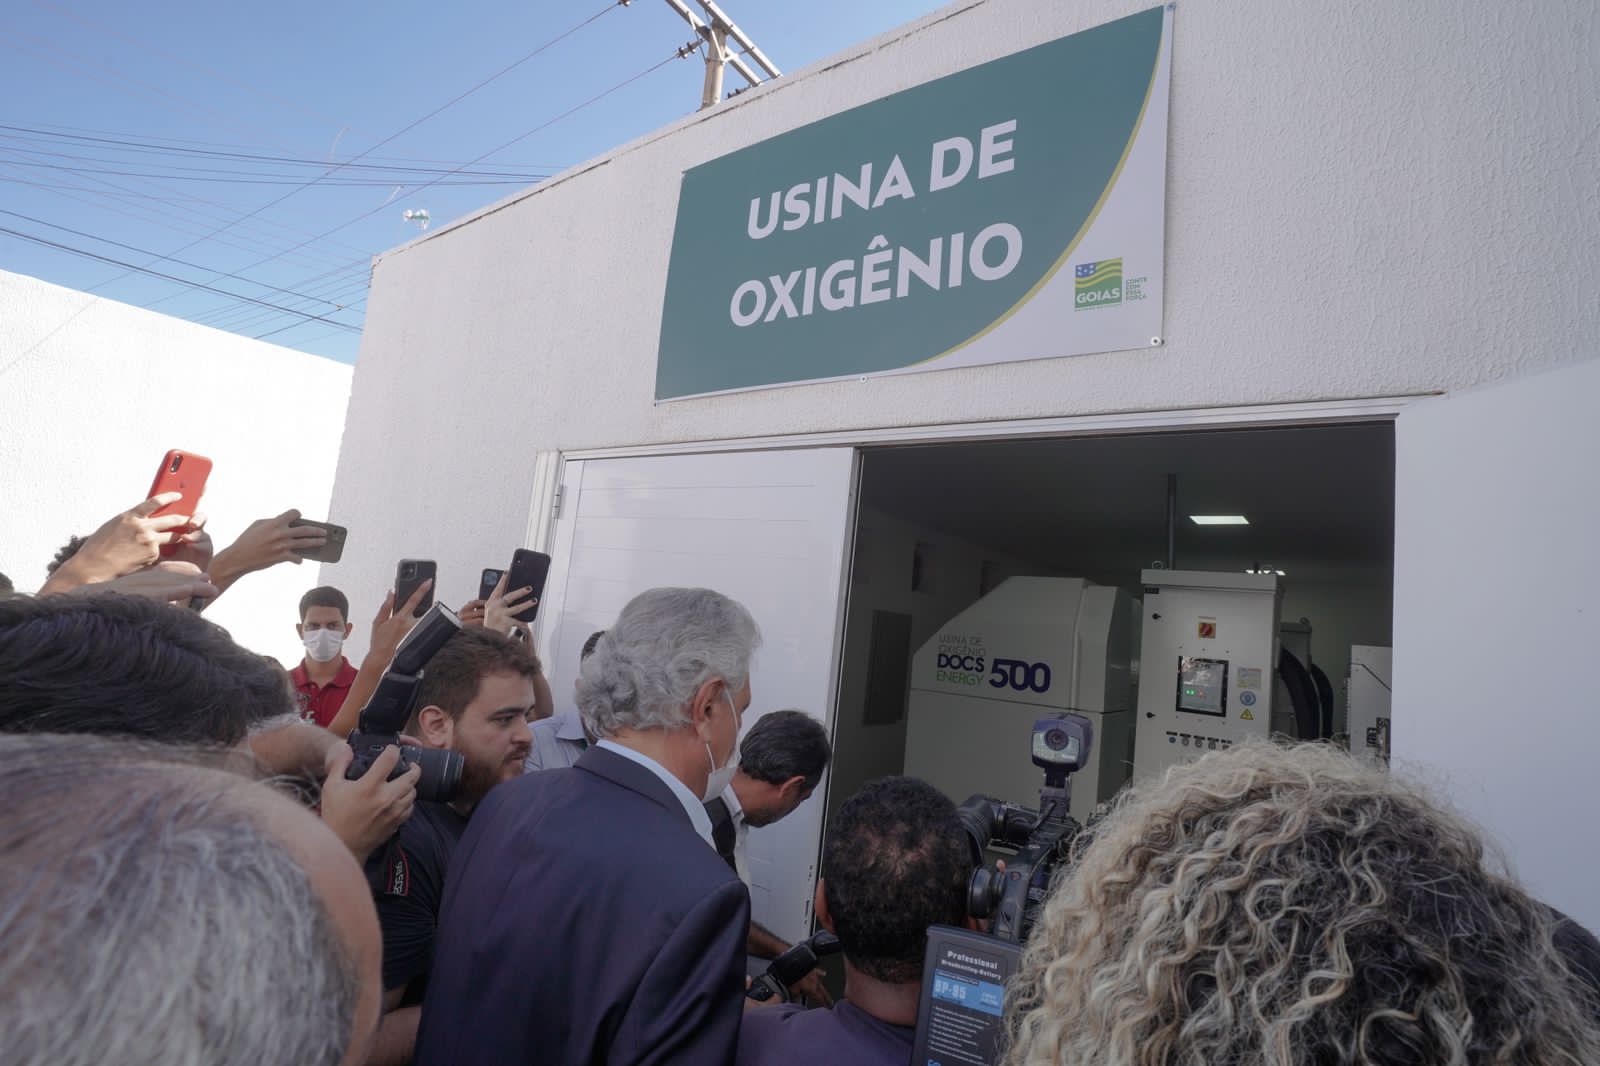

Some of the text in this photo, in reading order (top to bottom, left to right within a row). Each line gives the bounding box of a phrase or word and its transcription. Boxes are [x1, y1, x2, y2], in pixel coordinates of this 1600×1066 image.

[747, 119, 1017, 240] USINA DE
[729, 222, 1023, 328] OXIGÊNIO
[1076, 287, 1121, 304] GOIAS
[937, 653, 985, 673] DOCS
[936, 670, 984, 686] ENERGY
[988, 658, 1051, 694] 500
[947, 950, 998, 970] Professional
